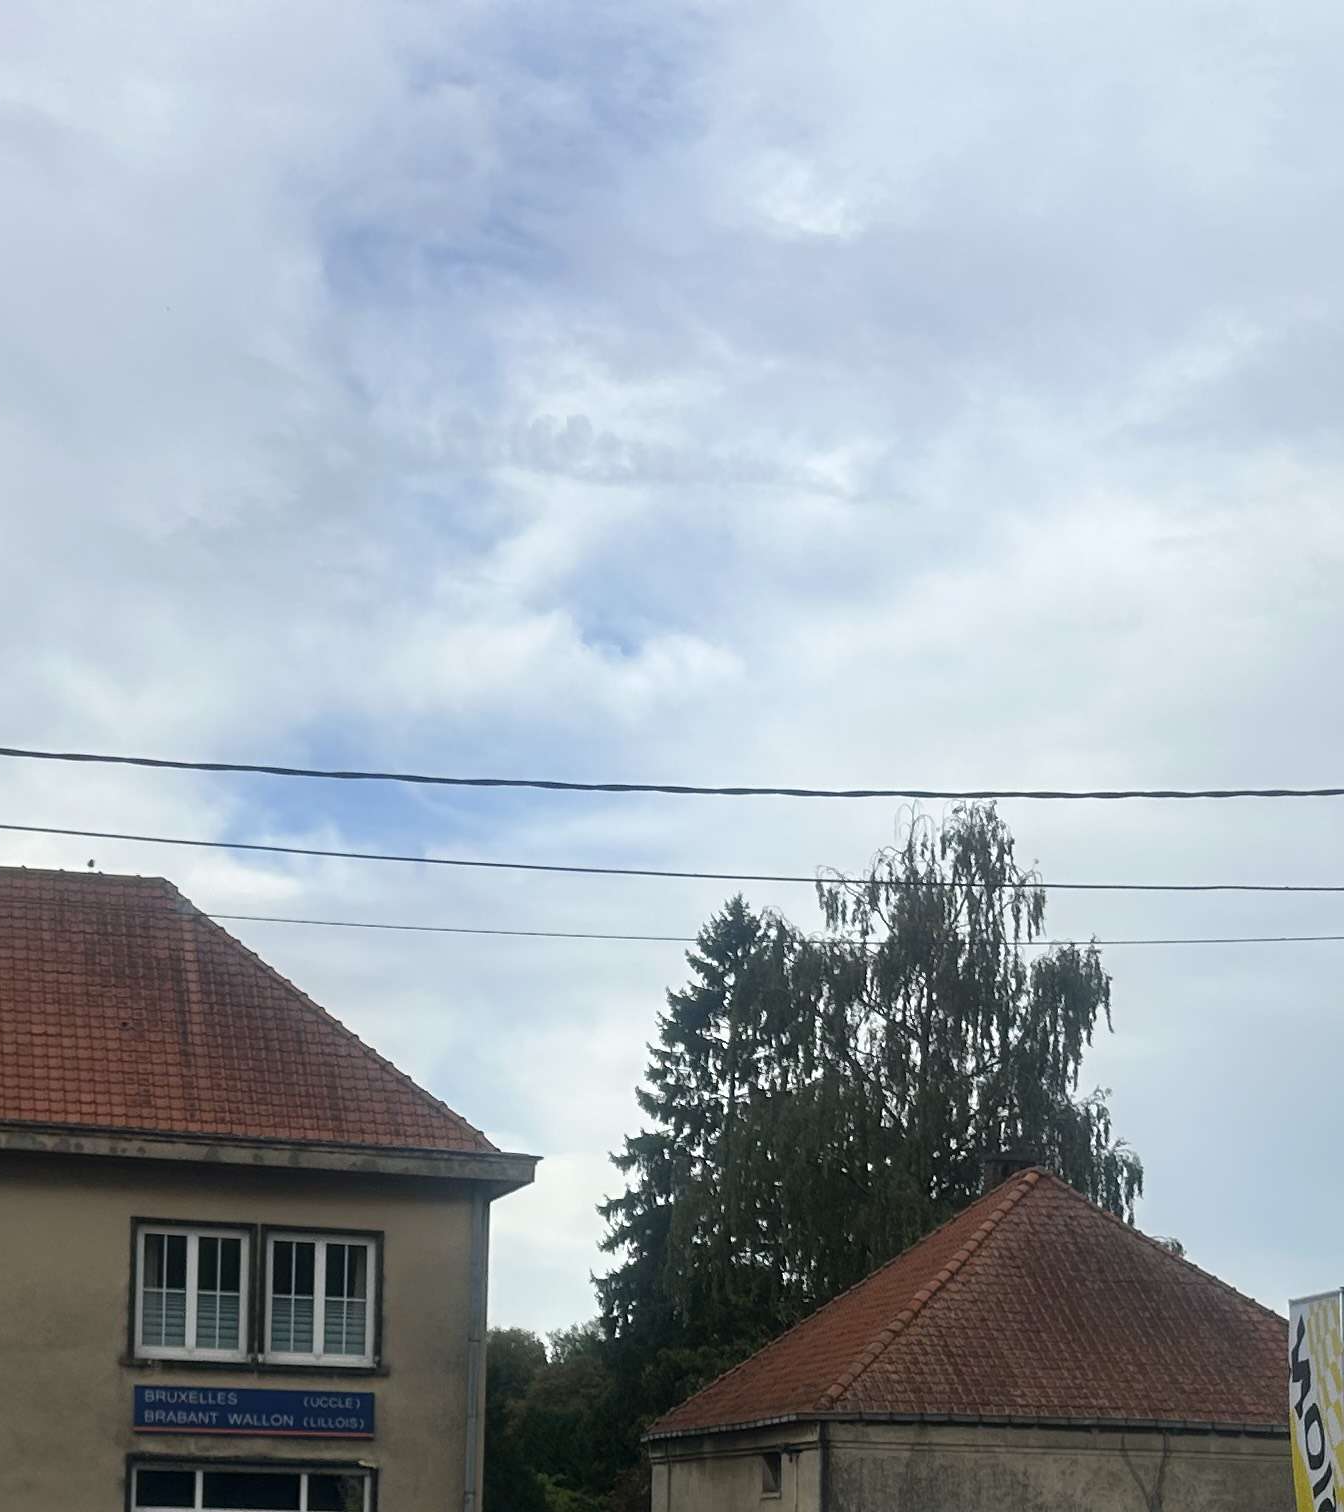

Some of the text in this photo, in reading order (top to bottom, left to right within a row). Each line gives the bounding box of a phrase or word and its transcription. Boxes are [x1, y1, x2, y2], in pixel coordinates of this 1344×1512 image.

[144, 1390, 238, 1405] BRUXELLES
[144, 1410, 219, 1425] BRABANT
[227, 1413, 294, 1427] WALLON
